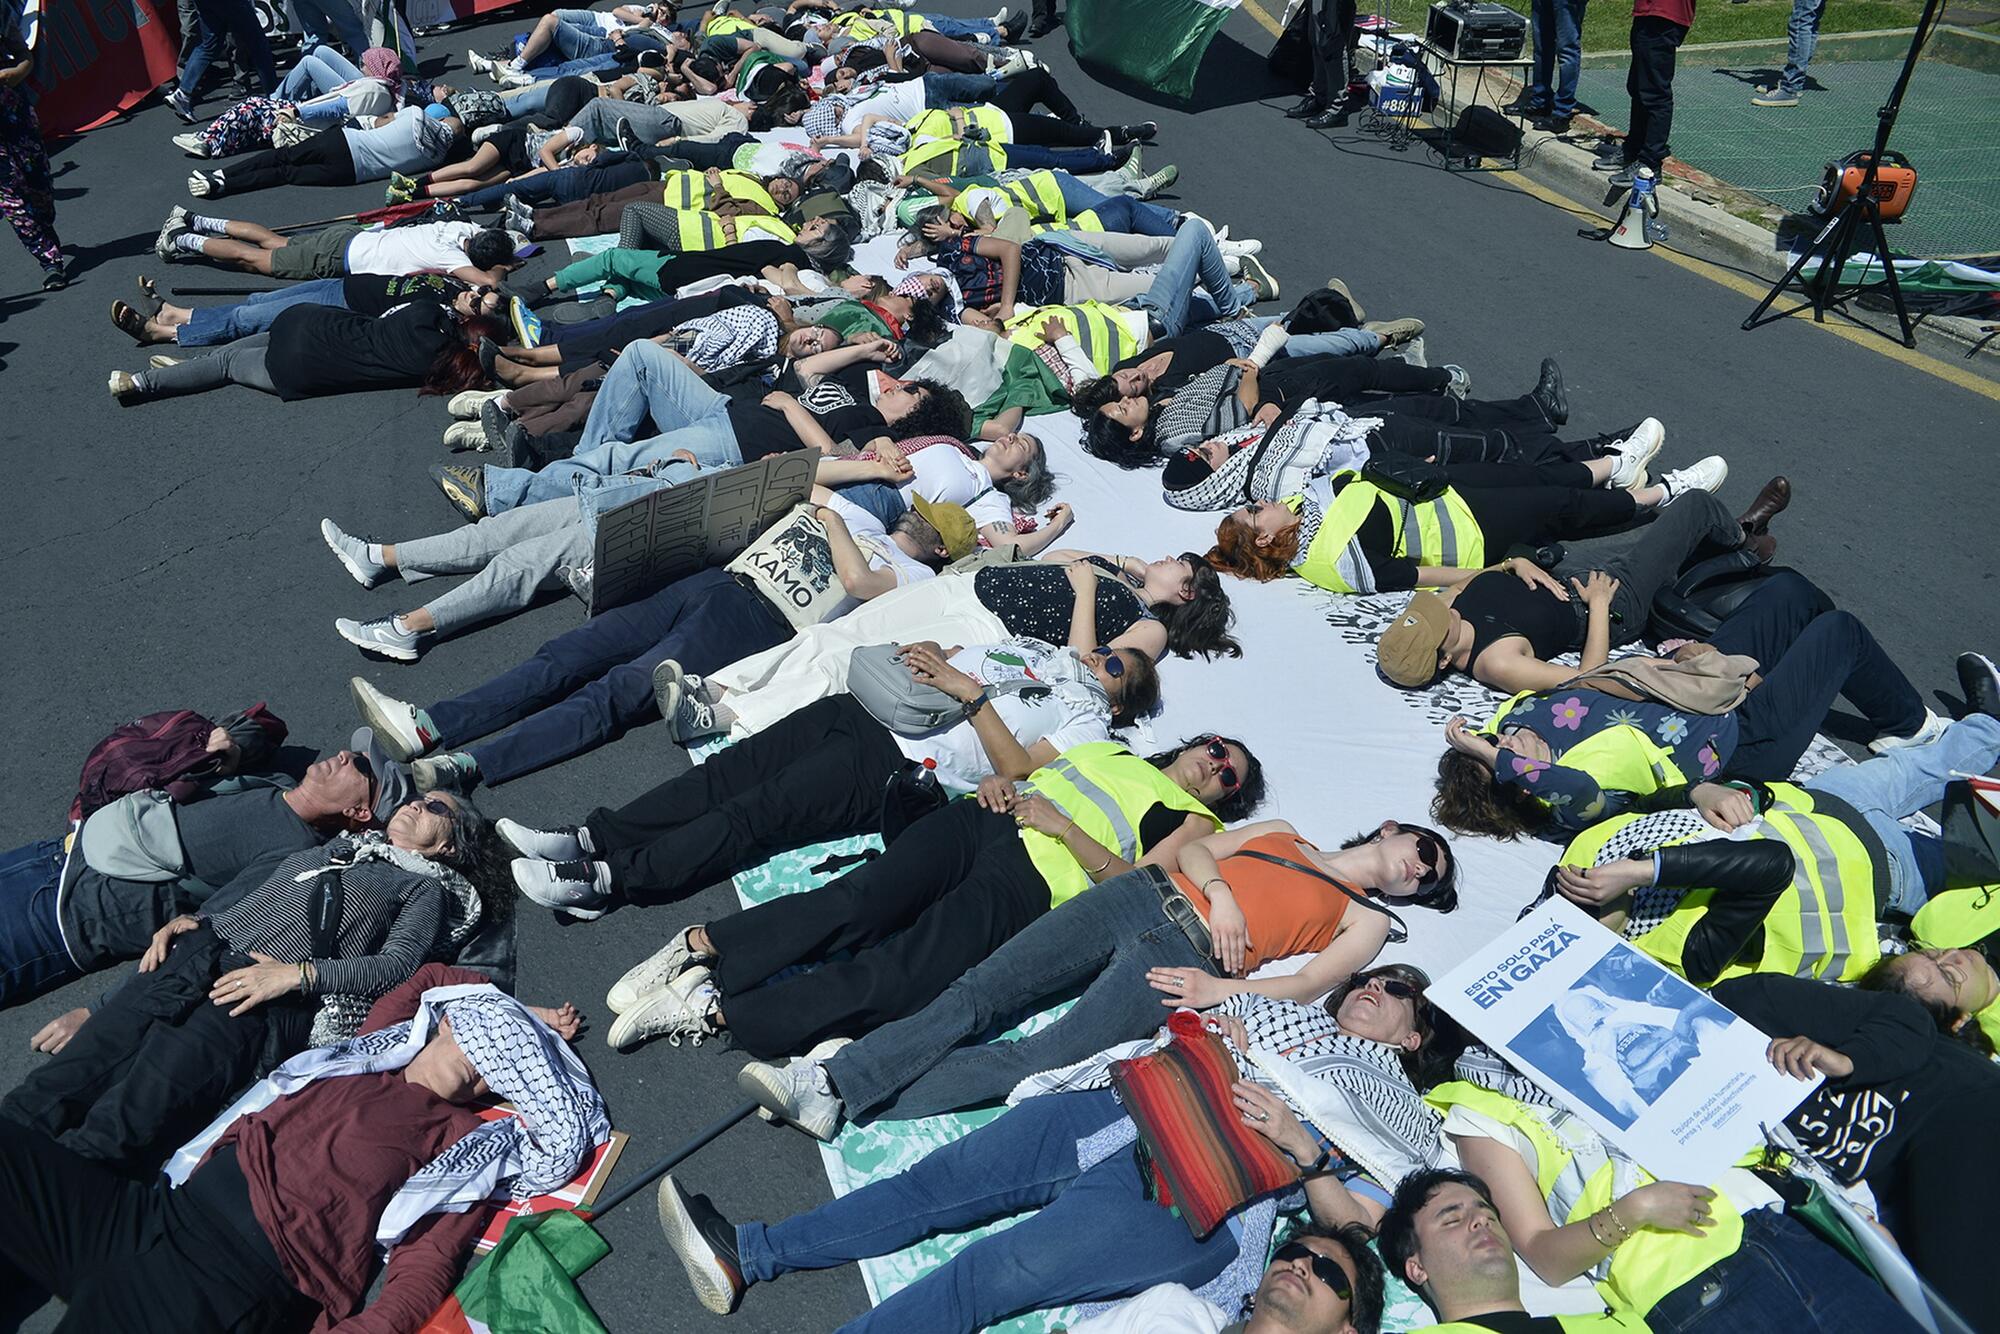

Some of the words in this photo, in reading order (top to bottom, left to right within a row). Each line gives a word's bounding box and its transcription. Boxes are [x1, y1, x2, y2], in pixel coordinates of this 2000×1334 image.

[710, 466, 761, 515] LIFT
[604, 498, 649, 565] FREE
[718, 516, 742, 547] THE
[746, 552, 812, 608] KAMO
[1464, 970, 1498, 997] ESTO
[1497, 946, 1531, 972] SOLO
[1472, 978, 1514, 1010] EN
[1509, 931, 1581, 981] GAZA
